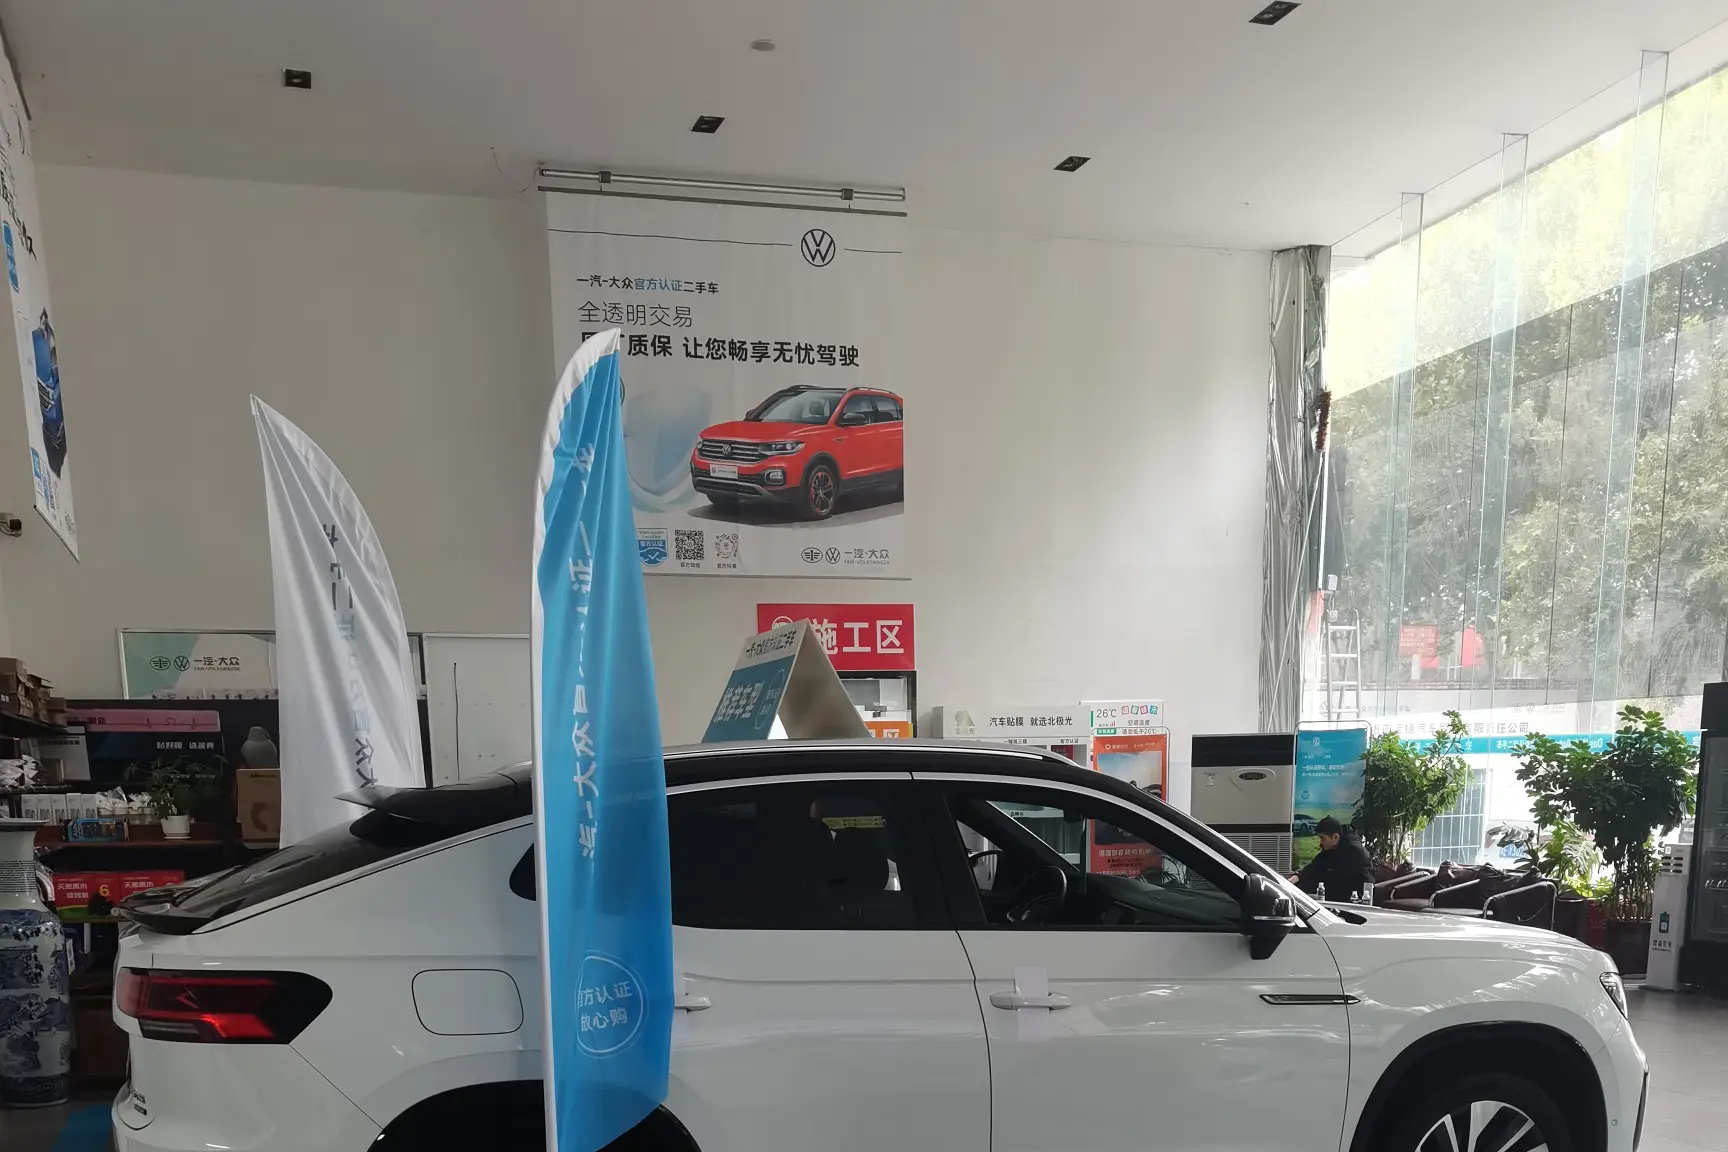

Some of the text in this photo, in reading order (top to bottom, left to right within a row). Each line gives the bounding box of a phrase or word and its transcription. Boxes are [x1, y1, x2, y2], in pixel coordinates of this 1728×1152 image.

[576, 274, 720, 295] 一汽-大众官方认证二手车
[578, 300, 693, 328] 全透明交易
[581, 331, 860, 367] 质保 让您畅享无忧驾驶
[810, 618, 904, 655] 施工区
[989, 716, 1072, 727] 汽车贴膜 就选北极光
